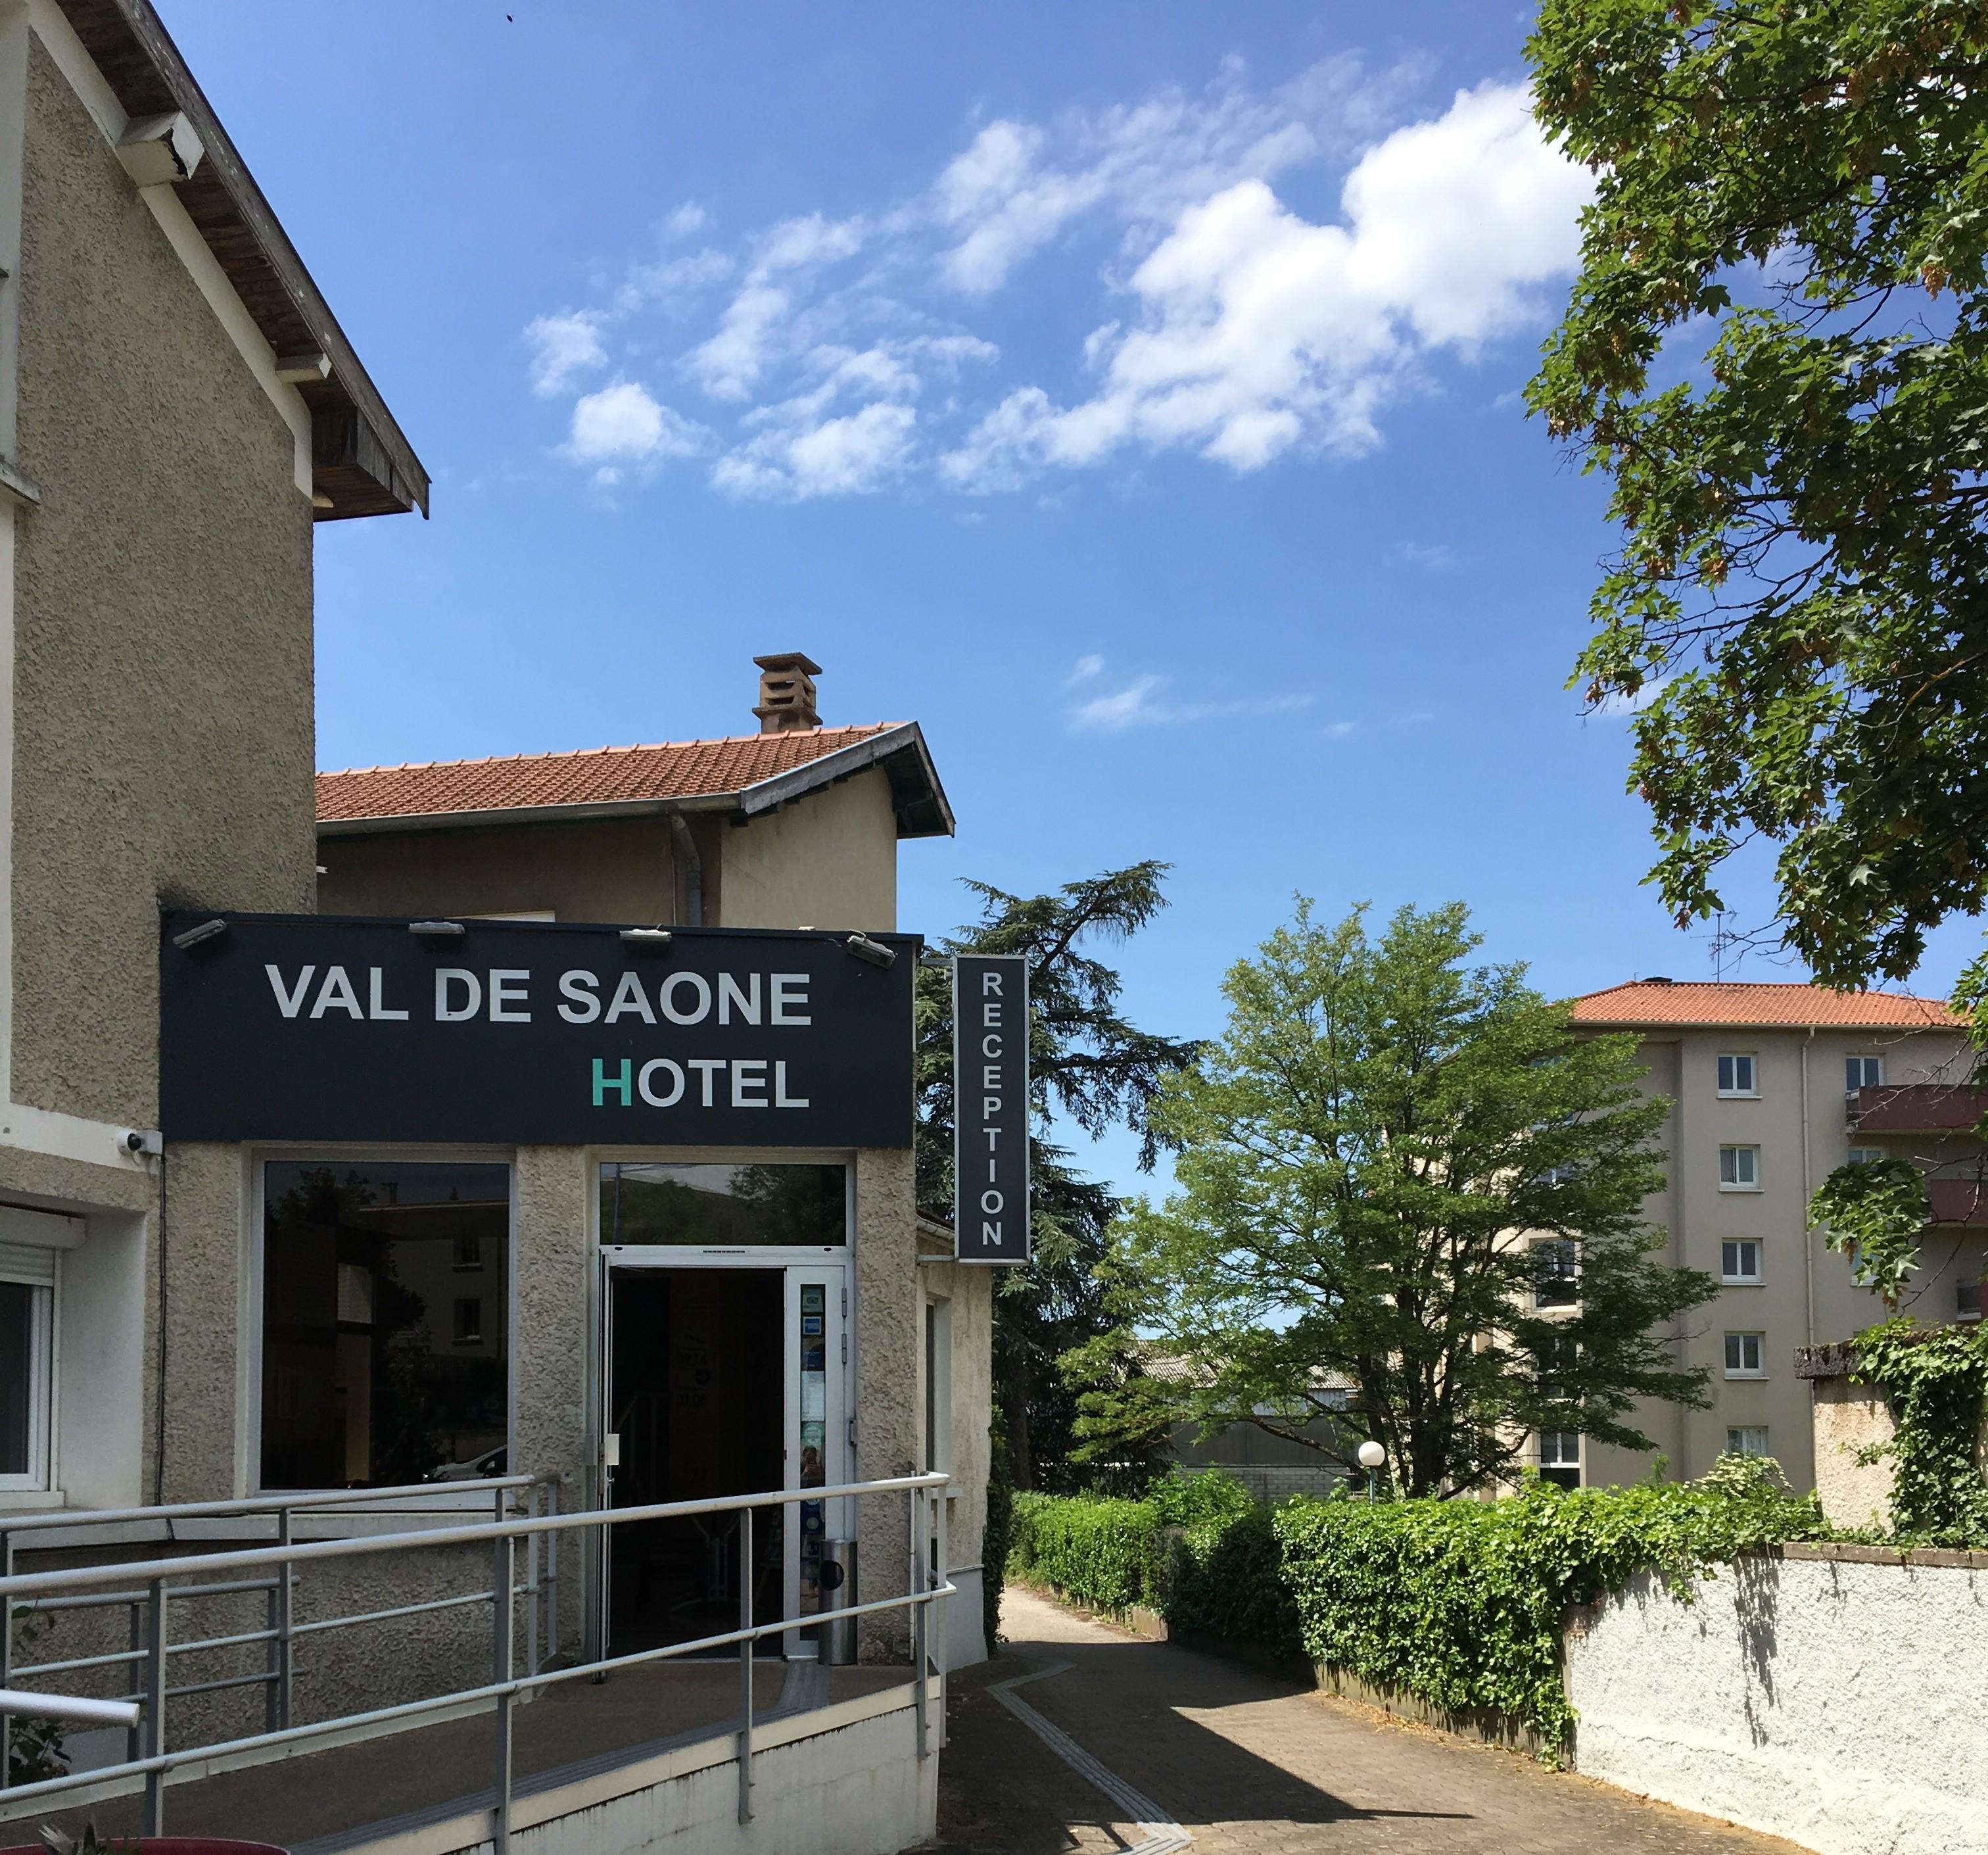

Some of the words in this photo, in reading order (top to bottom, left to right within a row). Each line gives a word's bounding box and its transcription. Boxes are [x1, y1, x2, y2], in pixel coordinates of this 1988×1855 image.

[264, 964, 409, 1021] VAL
[435, 968, 531, 1023] DE
[557, 969, 811, 1026] SAONE
[592, 1058, 809, 1107] HOTEL
[980, 972, 1005, 1246] RECEPTION
